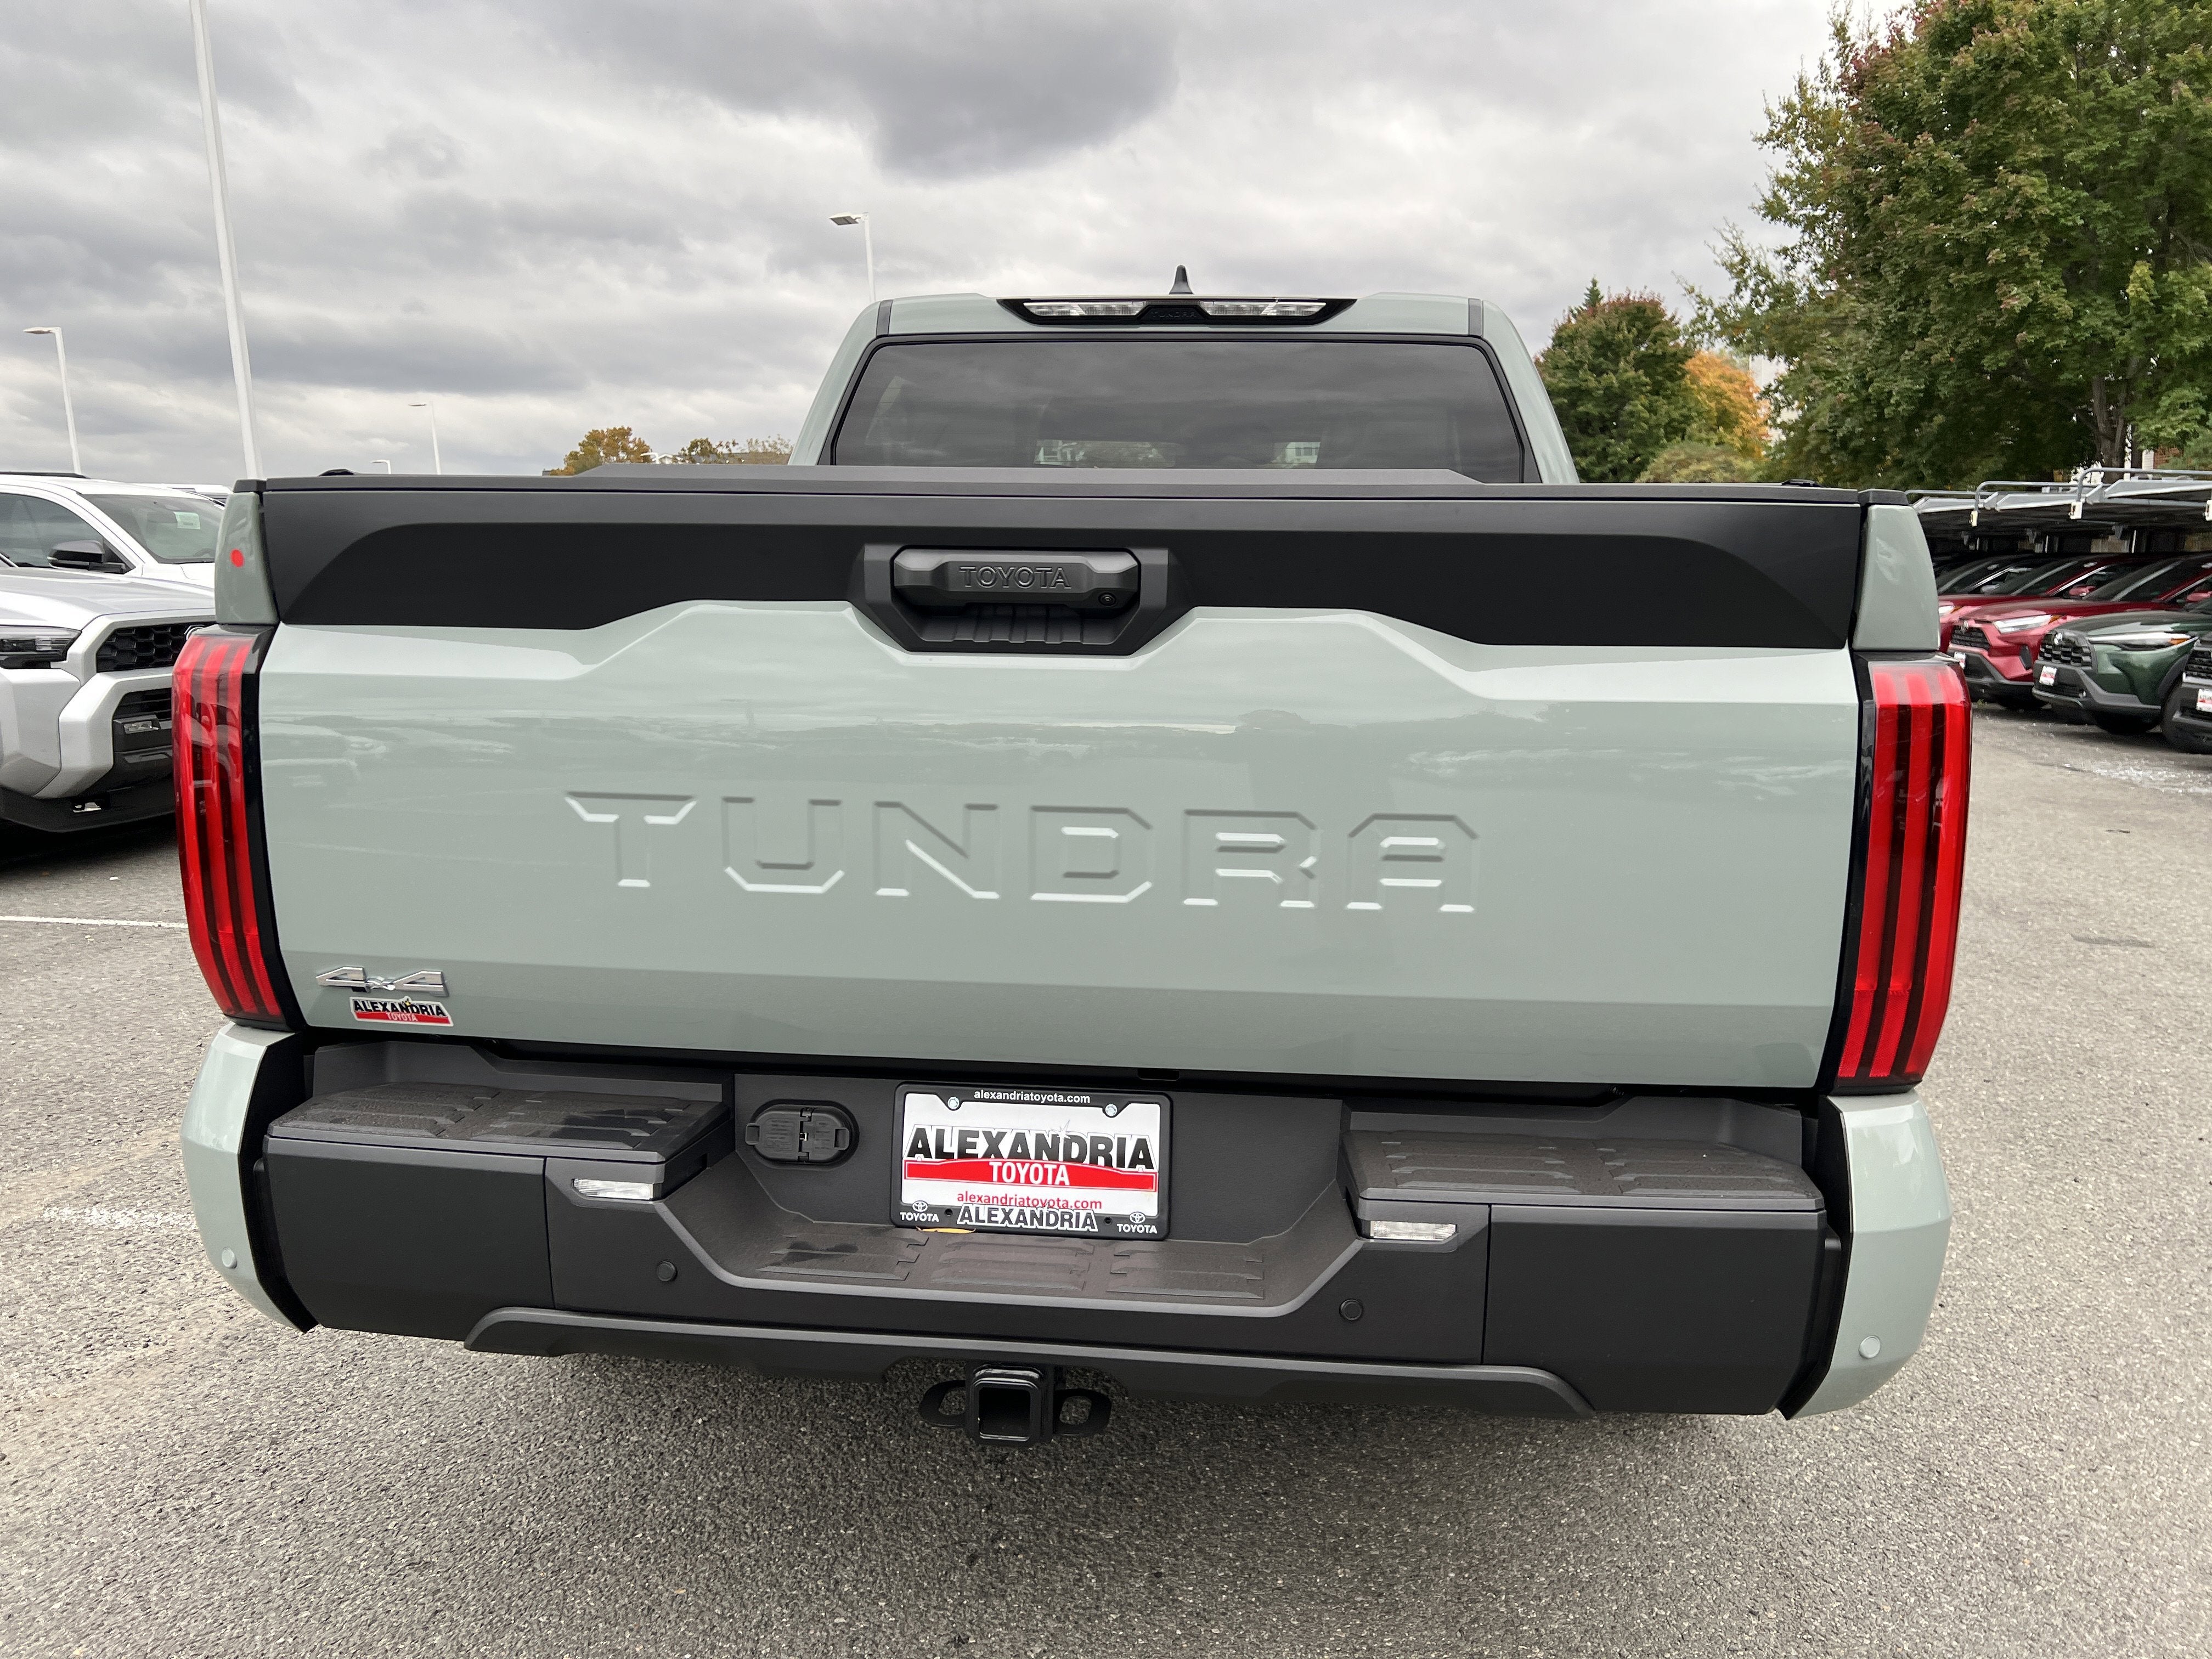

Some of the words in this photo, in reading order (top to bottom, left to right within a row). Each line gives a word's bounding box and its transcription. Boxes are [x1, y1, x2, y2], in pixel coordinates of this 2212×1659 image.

[959, 566, 1071, 589] TOYOTA
[565, 791, 1479, 913] TUNDRA
[354, 1000, 446, 1017] ALEXANDRIA
[385, 1012, 419, 1022] TOYOTA
[973, 1090, 1091, 1104] alexandriatoyota.com
[905, 1126, 1155, 1170] ALEXANDRIA
[989, 1161, 1070, 1186] TOYOTA
[900, 1211, 940, 1222] TOYOTA
[957, 1204, 1098, 1231] ALEXANDRIA
[1117, 1223, 1158, 1234] TOYOTA
